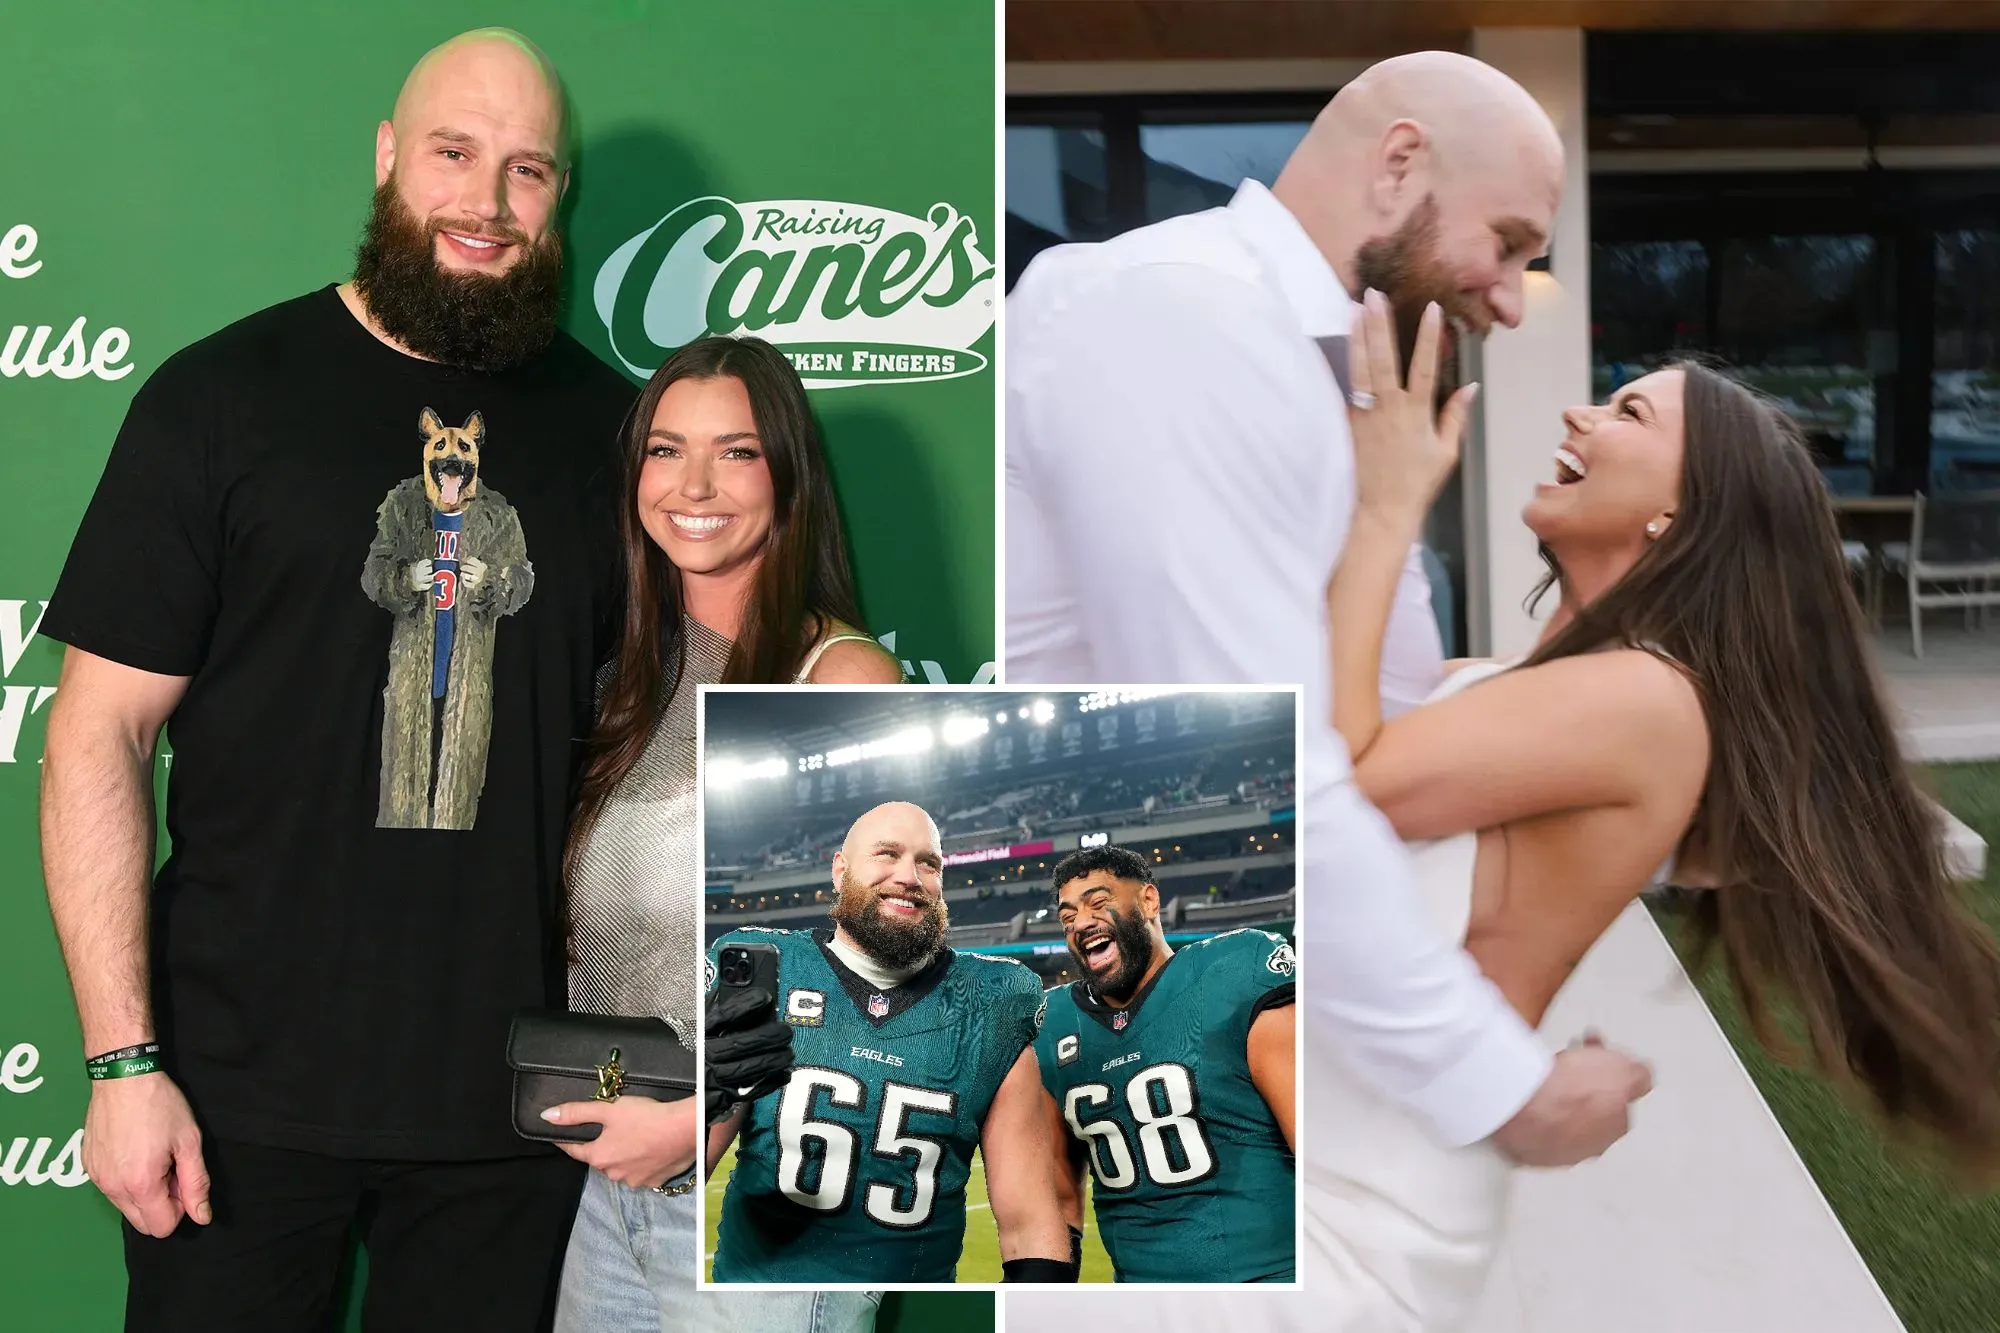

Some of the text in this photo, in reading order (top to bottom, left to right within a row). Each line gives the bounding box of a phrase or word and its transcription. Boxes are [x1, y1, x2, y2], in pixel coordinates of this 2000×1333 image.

[752, 208, 886, 244] Raising
[611, 197, 996, 371] Cane's
[787, 990, 825, 1017] C
[850, 1046, 905, 1067] EAGLES
[1057, 1035, 1078, 1060] C
[1101, 1051, 1141, 1072] EAGLES
[125, 1060, 154, 1074] xfinity
[1063, 1061, 1220, 1194] 68
[0, 1128, 90, 1188] us
[774, 1064, 960, 1231] 65
